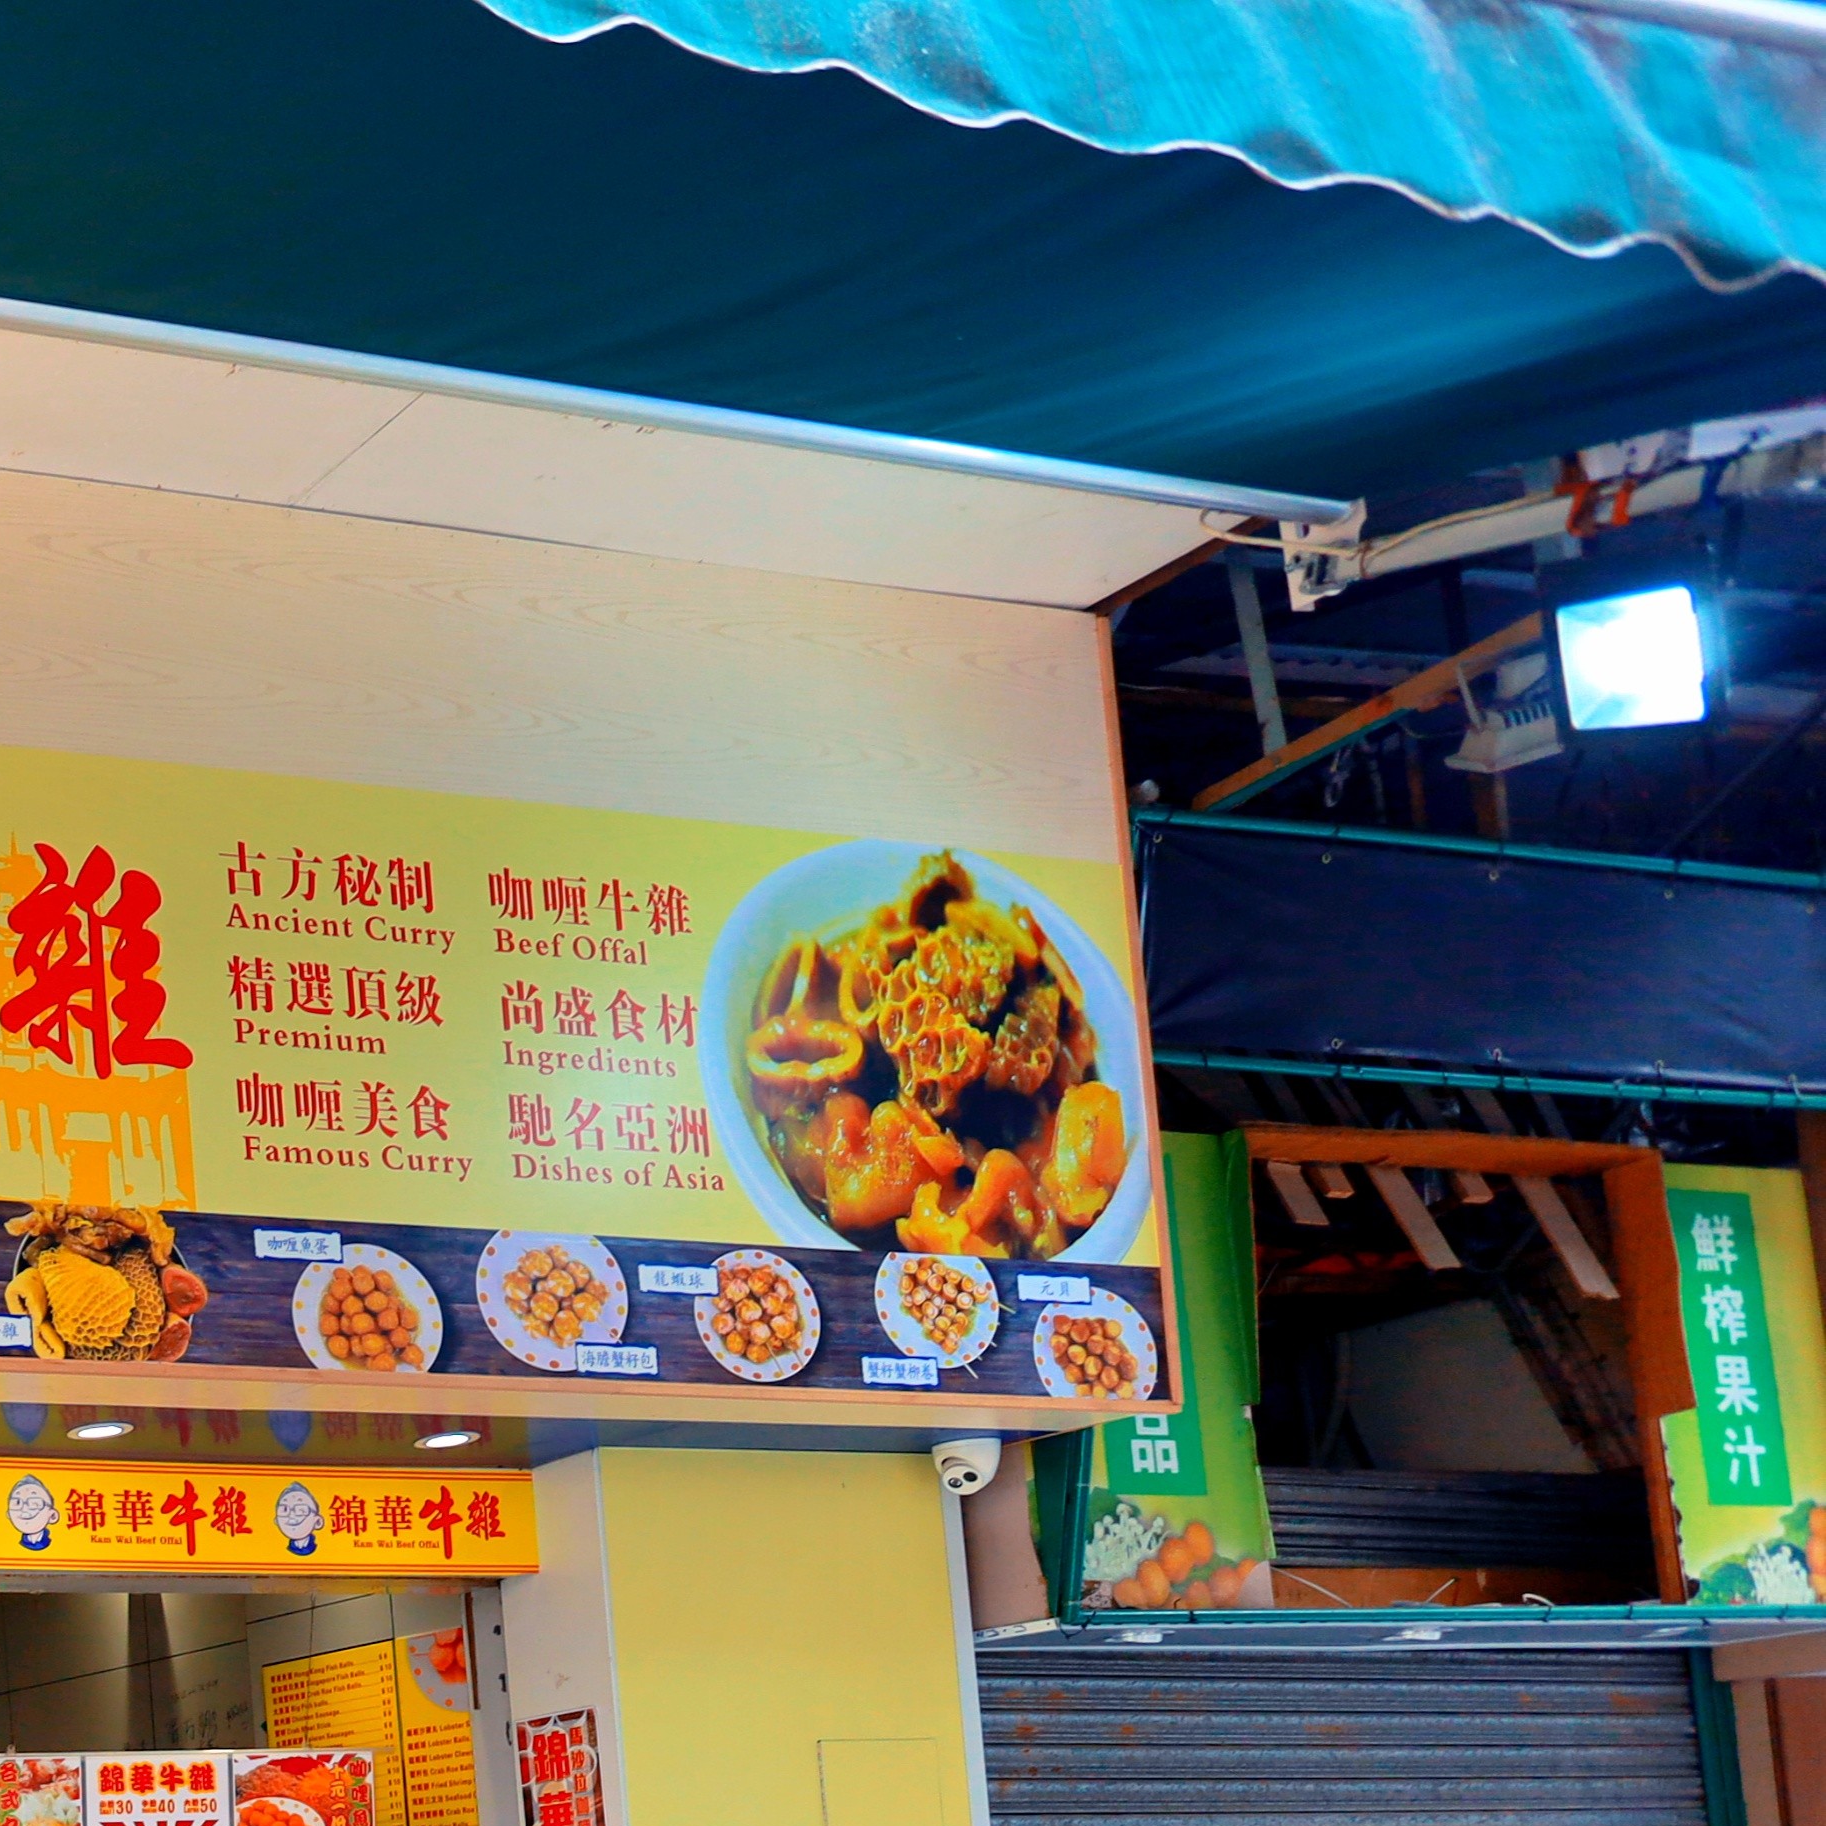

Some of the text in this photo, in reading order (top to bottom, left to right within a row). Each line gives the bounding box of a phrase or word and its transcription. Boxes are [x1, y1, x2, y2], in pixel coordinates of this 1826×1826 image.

[218, 841, 435, 914] 古方秘制
[488, 866, 693, 937] 咖喱牛雜
[225, 903, 456, 954] Ancient Curry
[494, 928, 648, 966] Beef Offal
[227, 955, 445, 1028] 精選頂級
[500, 979, 700, 1048] 尚盛食材
[233, 1018, 387, 1055] Premium
[502, 1041, 678, 1079] Ingredients
[235, 1072, 451, 1142] 咖喱美食
[508, 1093, 712, 1159] 馳名亞洲
[243, 1136, 473, 1181] Famous Curry
[513, 1155, 725, 1193] Dishes of Asia
[1041, 1280, 1070, 1297] 元貝
[1691, 1212, 1767, 1489] 鮮榨果汁
[90, 1534, 112, 1543] Kam
[135, 1535, 157, 1545] Beef
[159, 1535, 182, 1545] Offal
[353, 1539, 373, 1548] Kam
[396, 1540, 415, 1549] Beef
[418, 1540, 440, 1550] Offal
[99, 1761, 217, 1794] 錦華牛雜
[115, 1800, 133, 1814] 30
[158, 1799, 175, 1813] 40
[200, 1798, 217, 1813] 50
